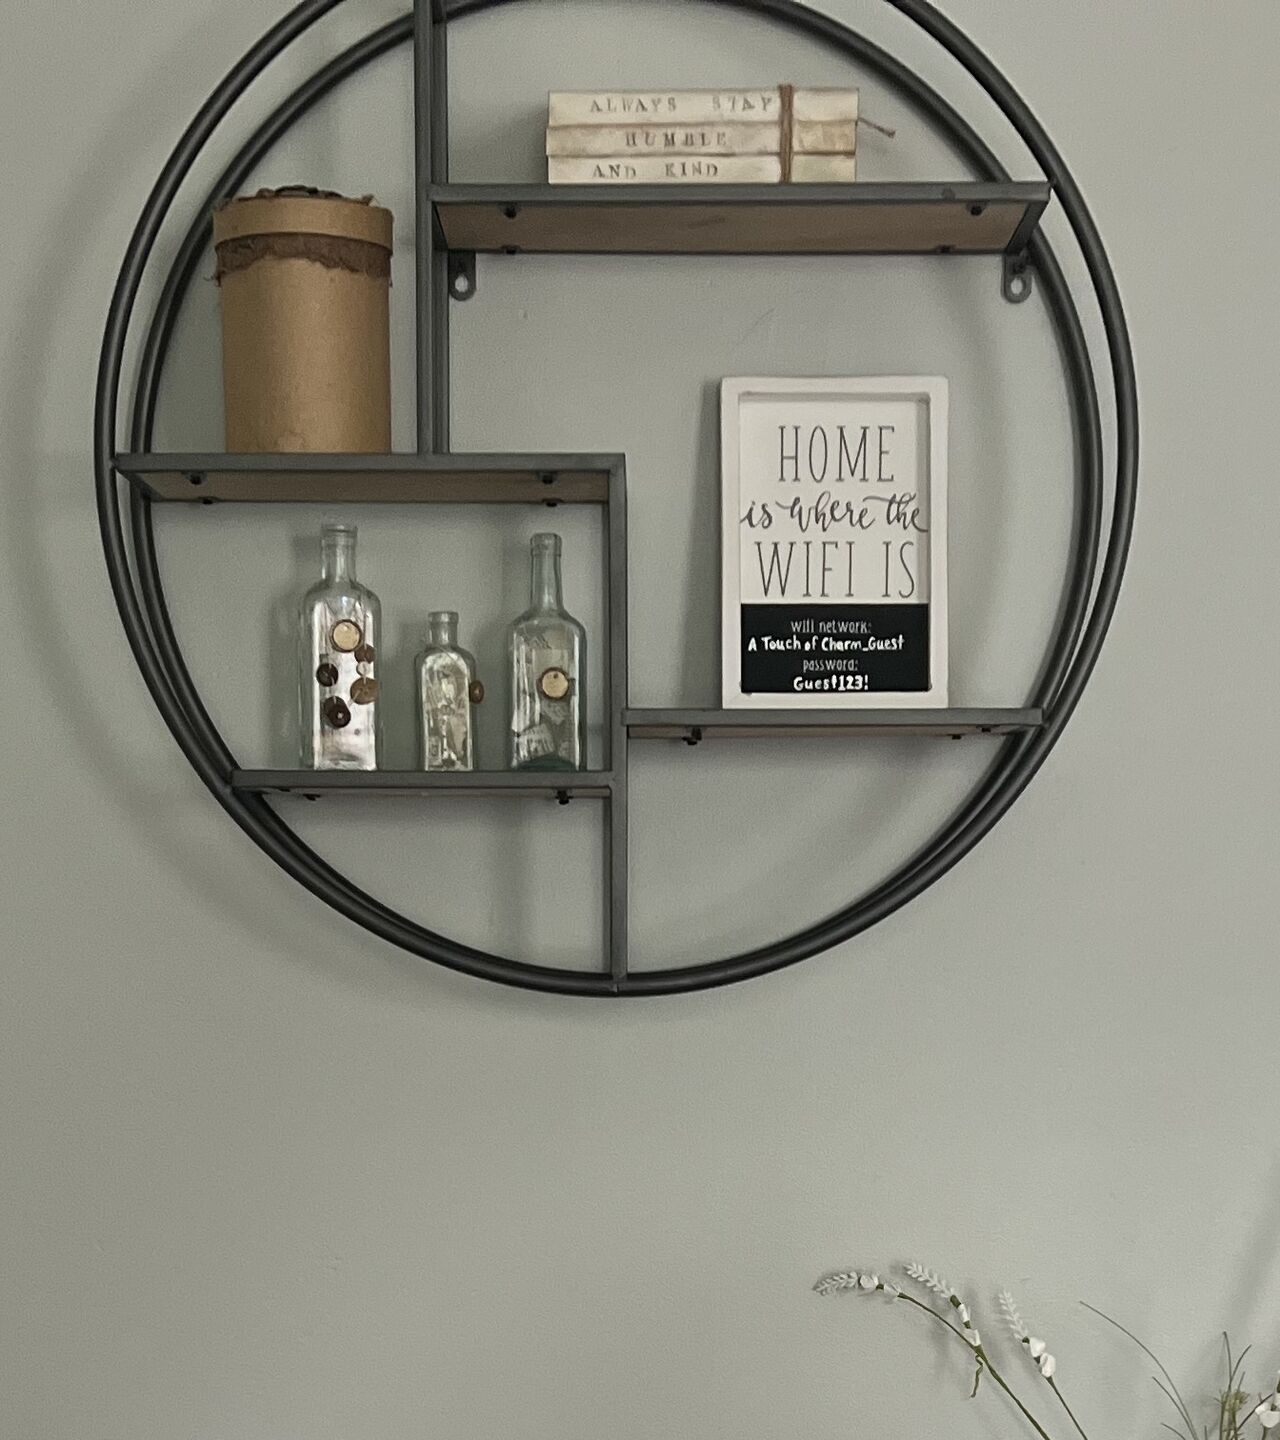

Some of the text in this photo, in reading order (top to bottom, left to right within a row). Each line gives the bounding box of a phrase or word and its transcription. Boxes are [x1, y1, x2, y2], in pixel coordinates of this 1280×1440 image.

[590, 96, 773, 113] ALWAYS STAY
[625, 131, 727, 148] HUMBLE
[592, 161, 719, 179] AND KIND
[778, 425, 895, 482] HOME
[739, 490, 929, 533] is where the
[754, 539, 916, 599] WIFI IS
[748, 636, 758, 652] A
[761, 635, 802, 651] Touch
[804, 635, 818, 651] of
[803, 658, 859, 673] password:
[793, 674, 869, 692] Guest123!
